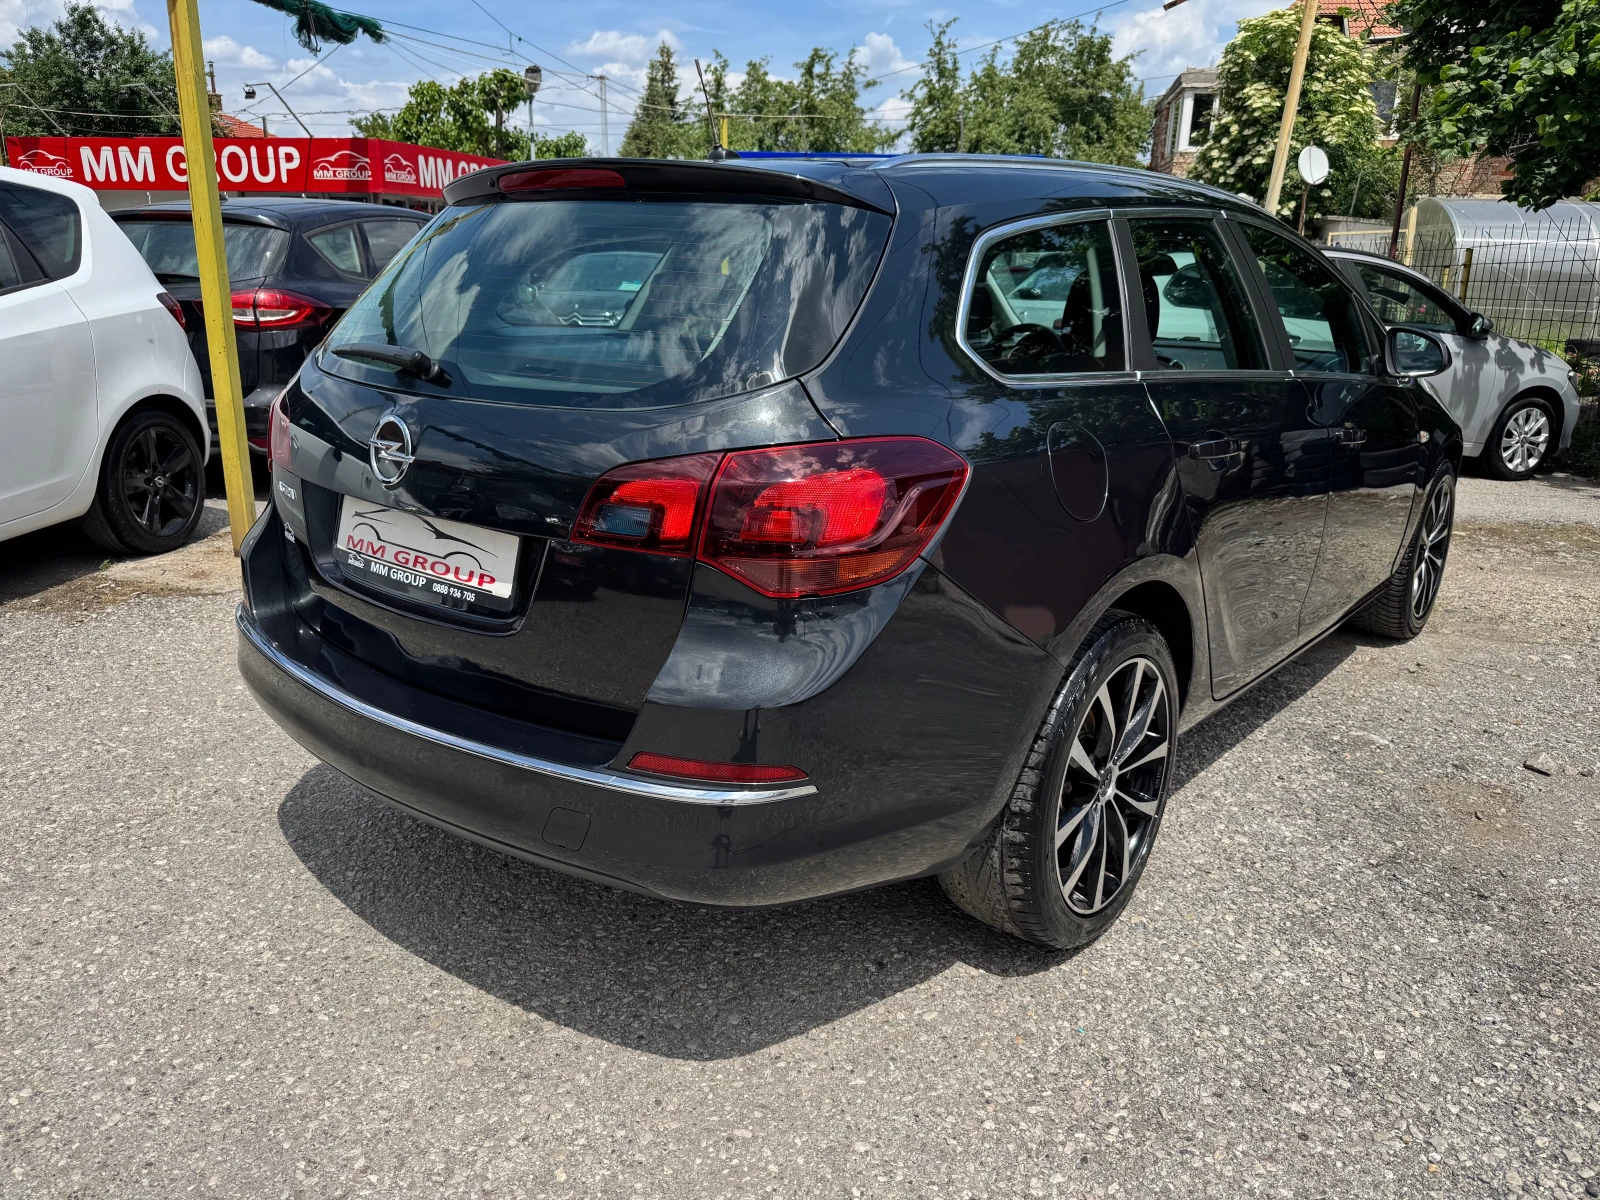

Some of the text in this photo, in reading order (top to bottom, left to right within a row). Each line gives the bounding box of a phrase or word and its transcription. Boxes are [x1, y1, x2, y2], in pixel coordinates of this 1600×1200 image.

[40, 168, 73, 176] GROUP
[80, 145, 301, 184] MM GOUP
[313, 169, 372, 178] MM GROUP
[384, 171, 398, 181] MM
[417, 154, 455, 190] MM
[346, 534, 497, 588] MM GROUP
[370, 561, 389, 577] MM
[389, 568, 427, 588] GROUP
[432, 582, 450, 595] 0888
[449, 587, 462, 599] 936
[462, 591, 476, 602] 705
